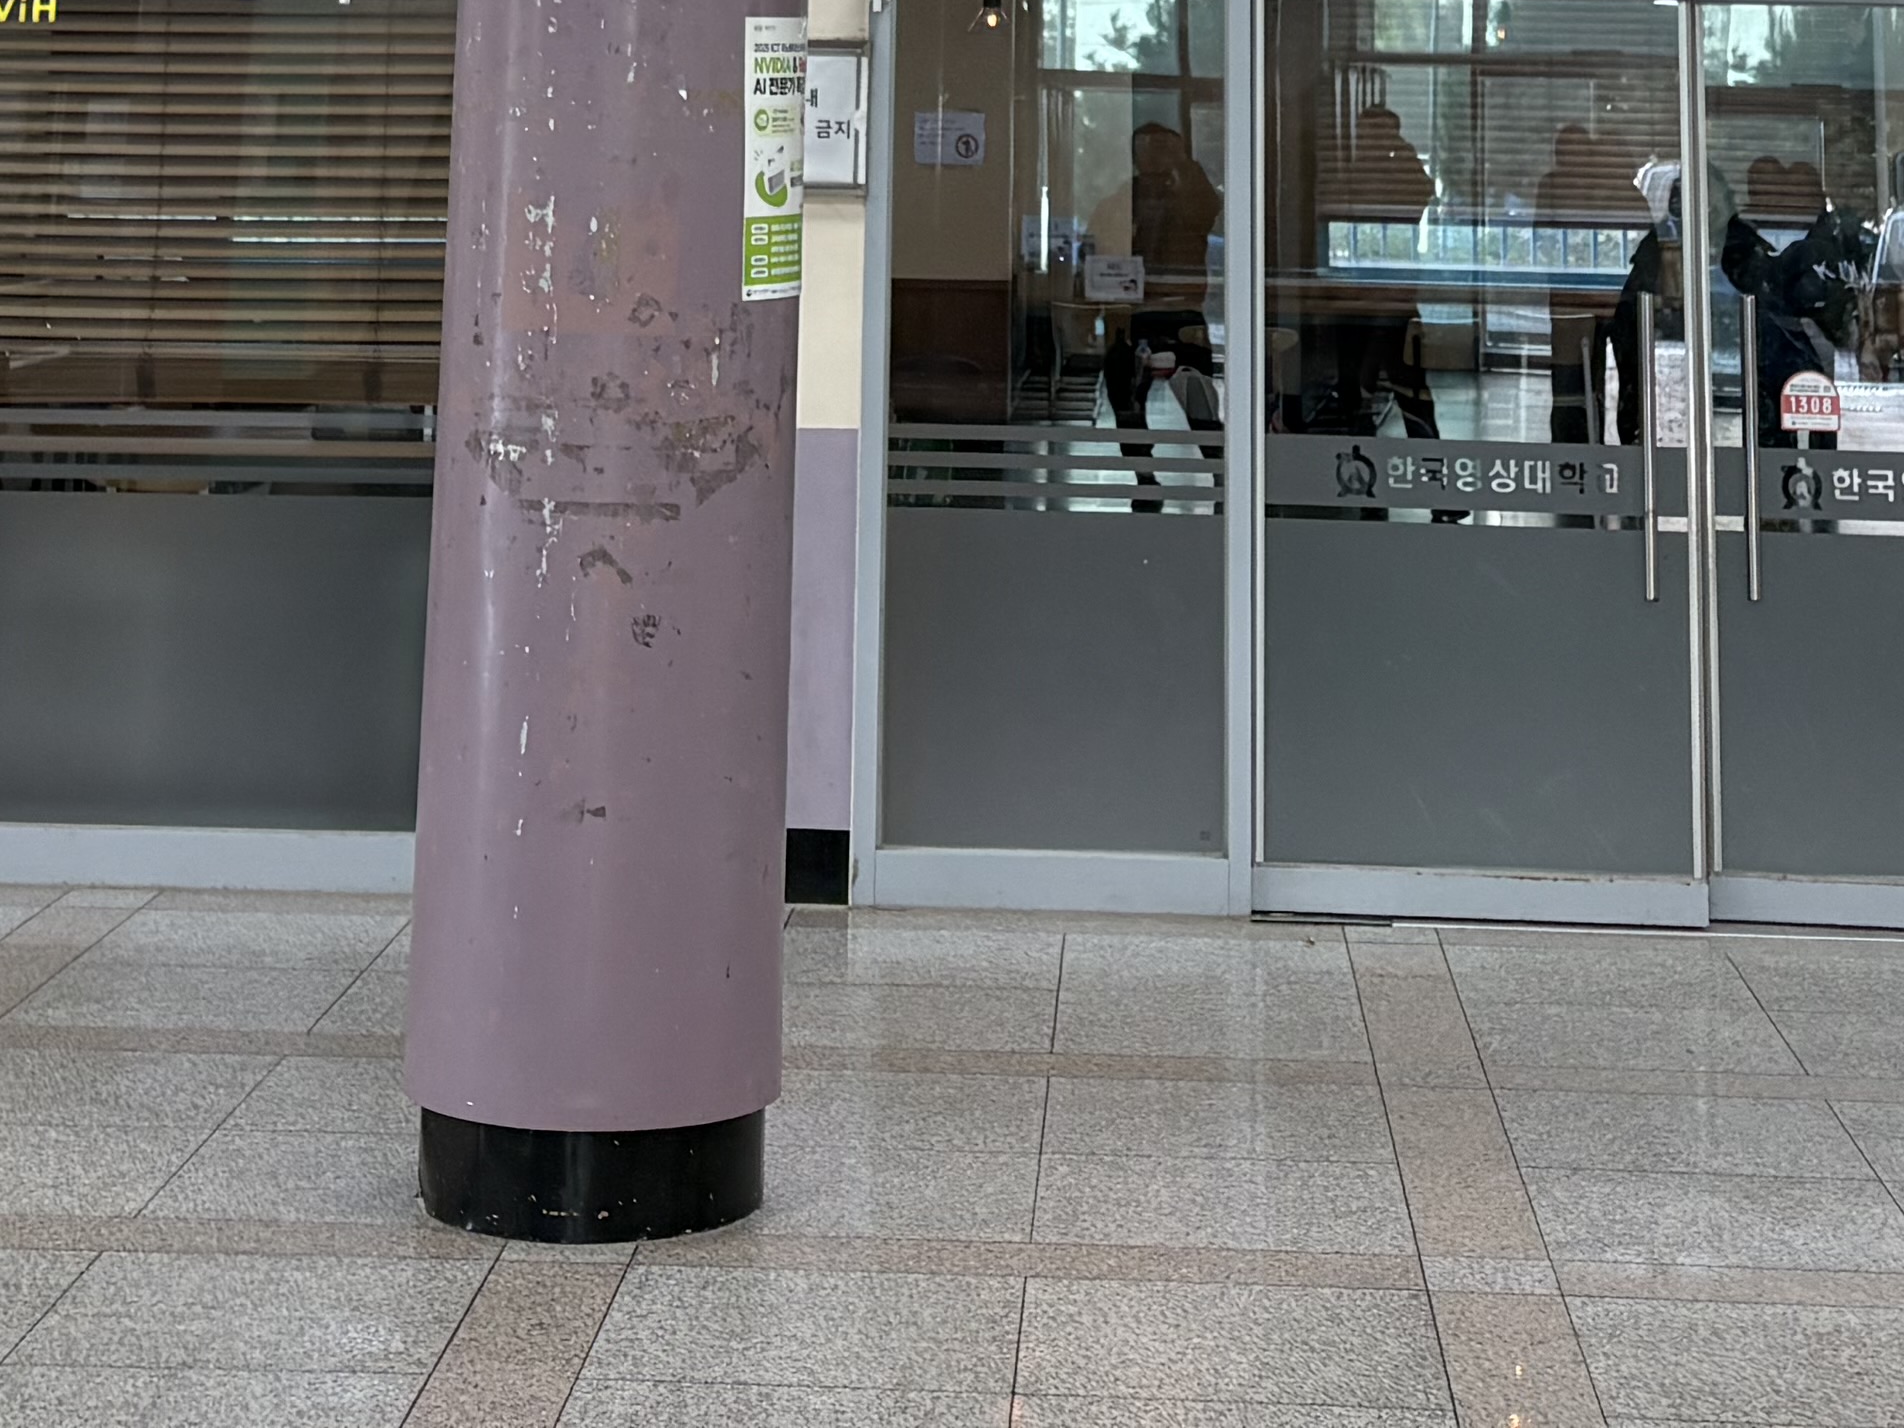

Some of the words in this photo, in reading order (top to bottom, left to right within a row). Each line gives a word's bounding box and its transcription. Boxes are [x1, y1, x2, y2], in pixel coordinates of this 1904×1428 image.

[754, 56, 792, 75] NVIDIA
[753, 77, 767, 96] AI
[814, 118, 851, 140] 금지
[1789, 396, 1833, 414] 1308
